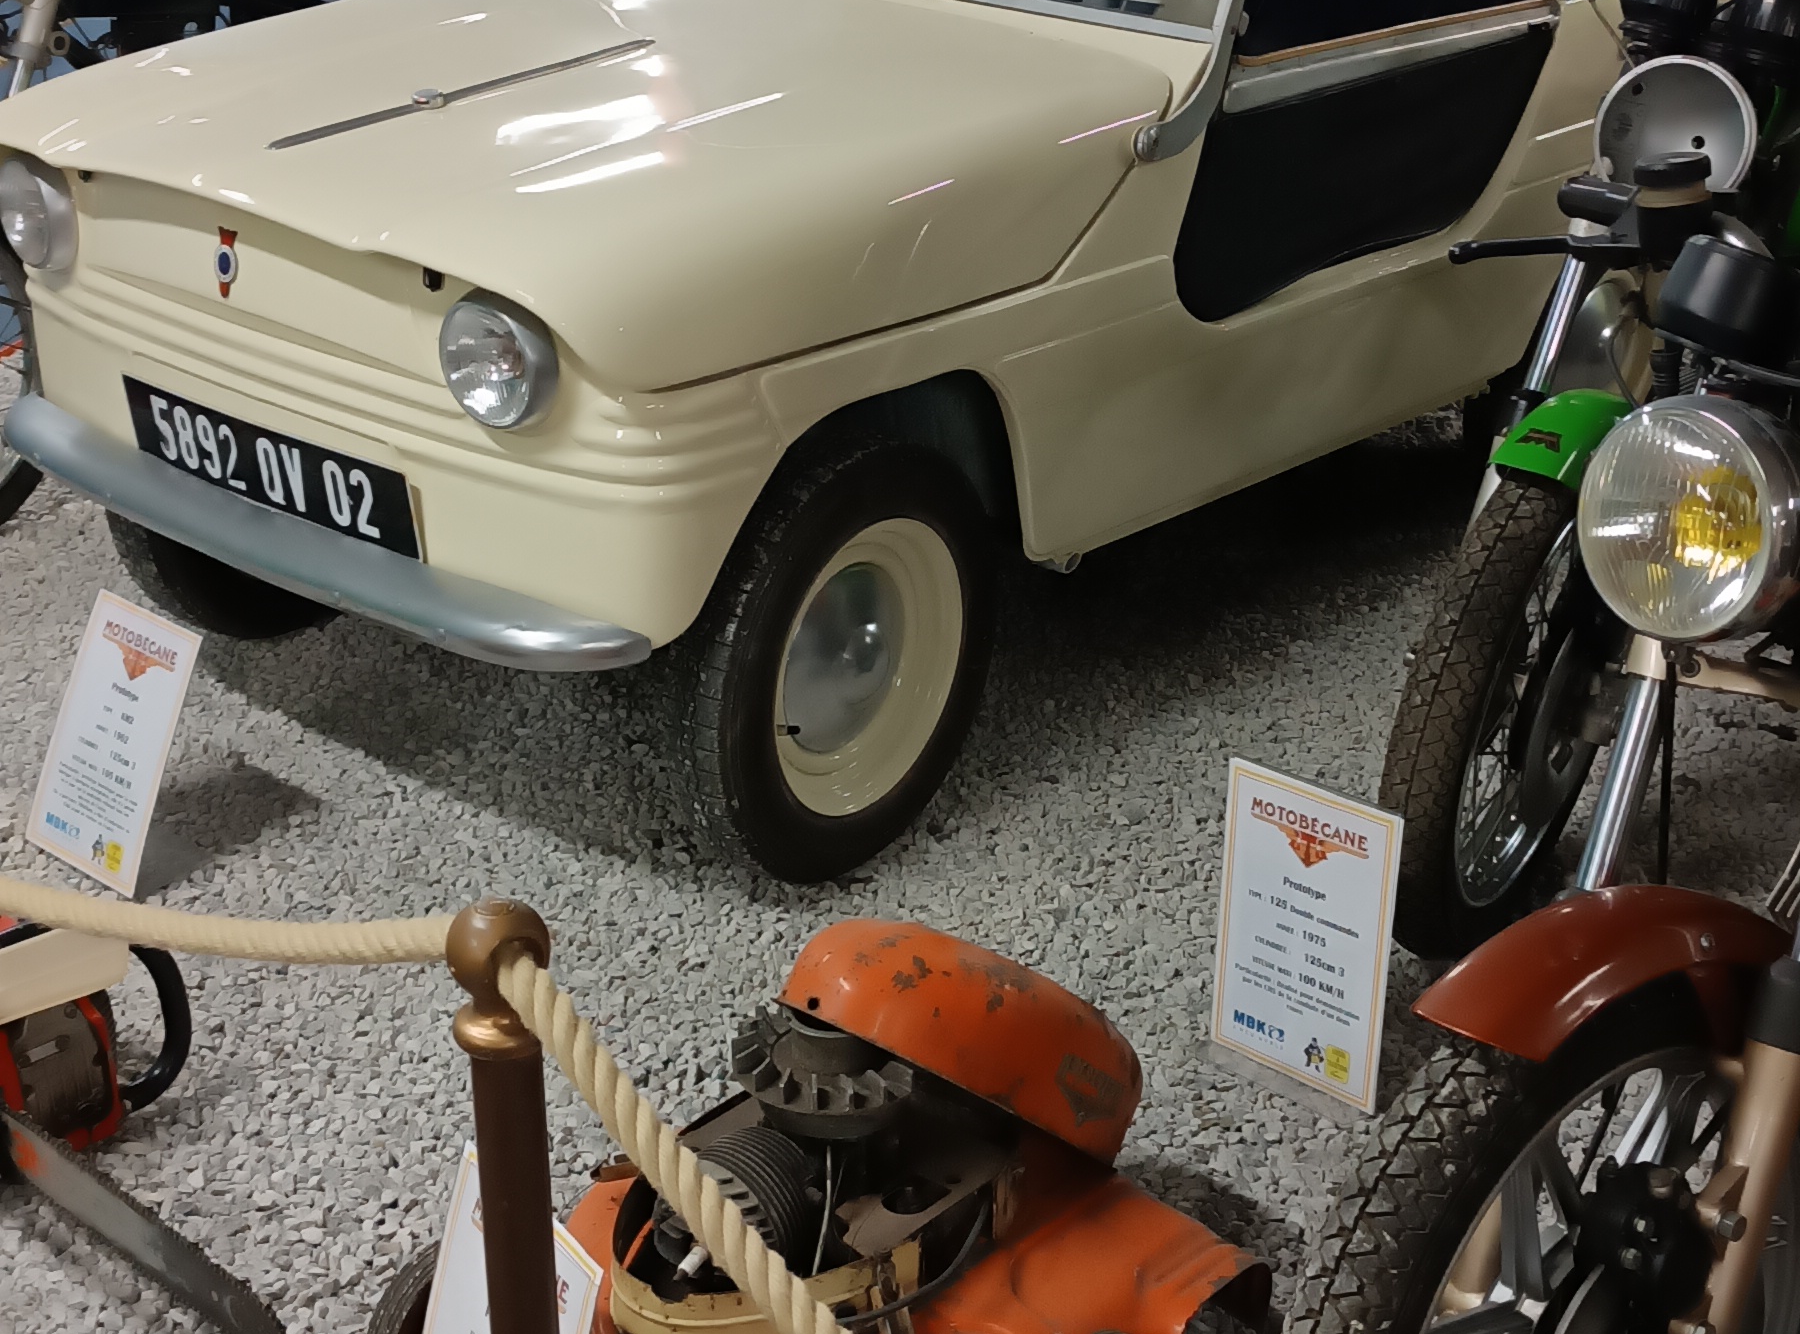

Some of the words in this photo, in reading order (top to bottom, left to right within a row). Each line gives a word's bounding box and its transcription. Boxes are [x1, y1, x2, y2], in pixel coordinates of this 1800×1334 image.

[150, 394, 247, 491] 5892
[255, 437, 307, 512] QV
[322, 460, 381, 539] 02
[1251, 796, 1368, 851] MOTOBÉCANE
[1283, 876, 1326, 901] Prototype
[1270, 896, 1288, 909] 125
[1302, 930, 1326, 948] 1975
[1304, 953, 1336, 974] 125cm
[1338, 967, 1345, 978] 3
[1298, 972, 1316, 987] 100
[1319, 981, 1345, 999] KM/H
[1233, 1009, 1266, 1035] MBK
